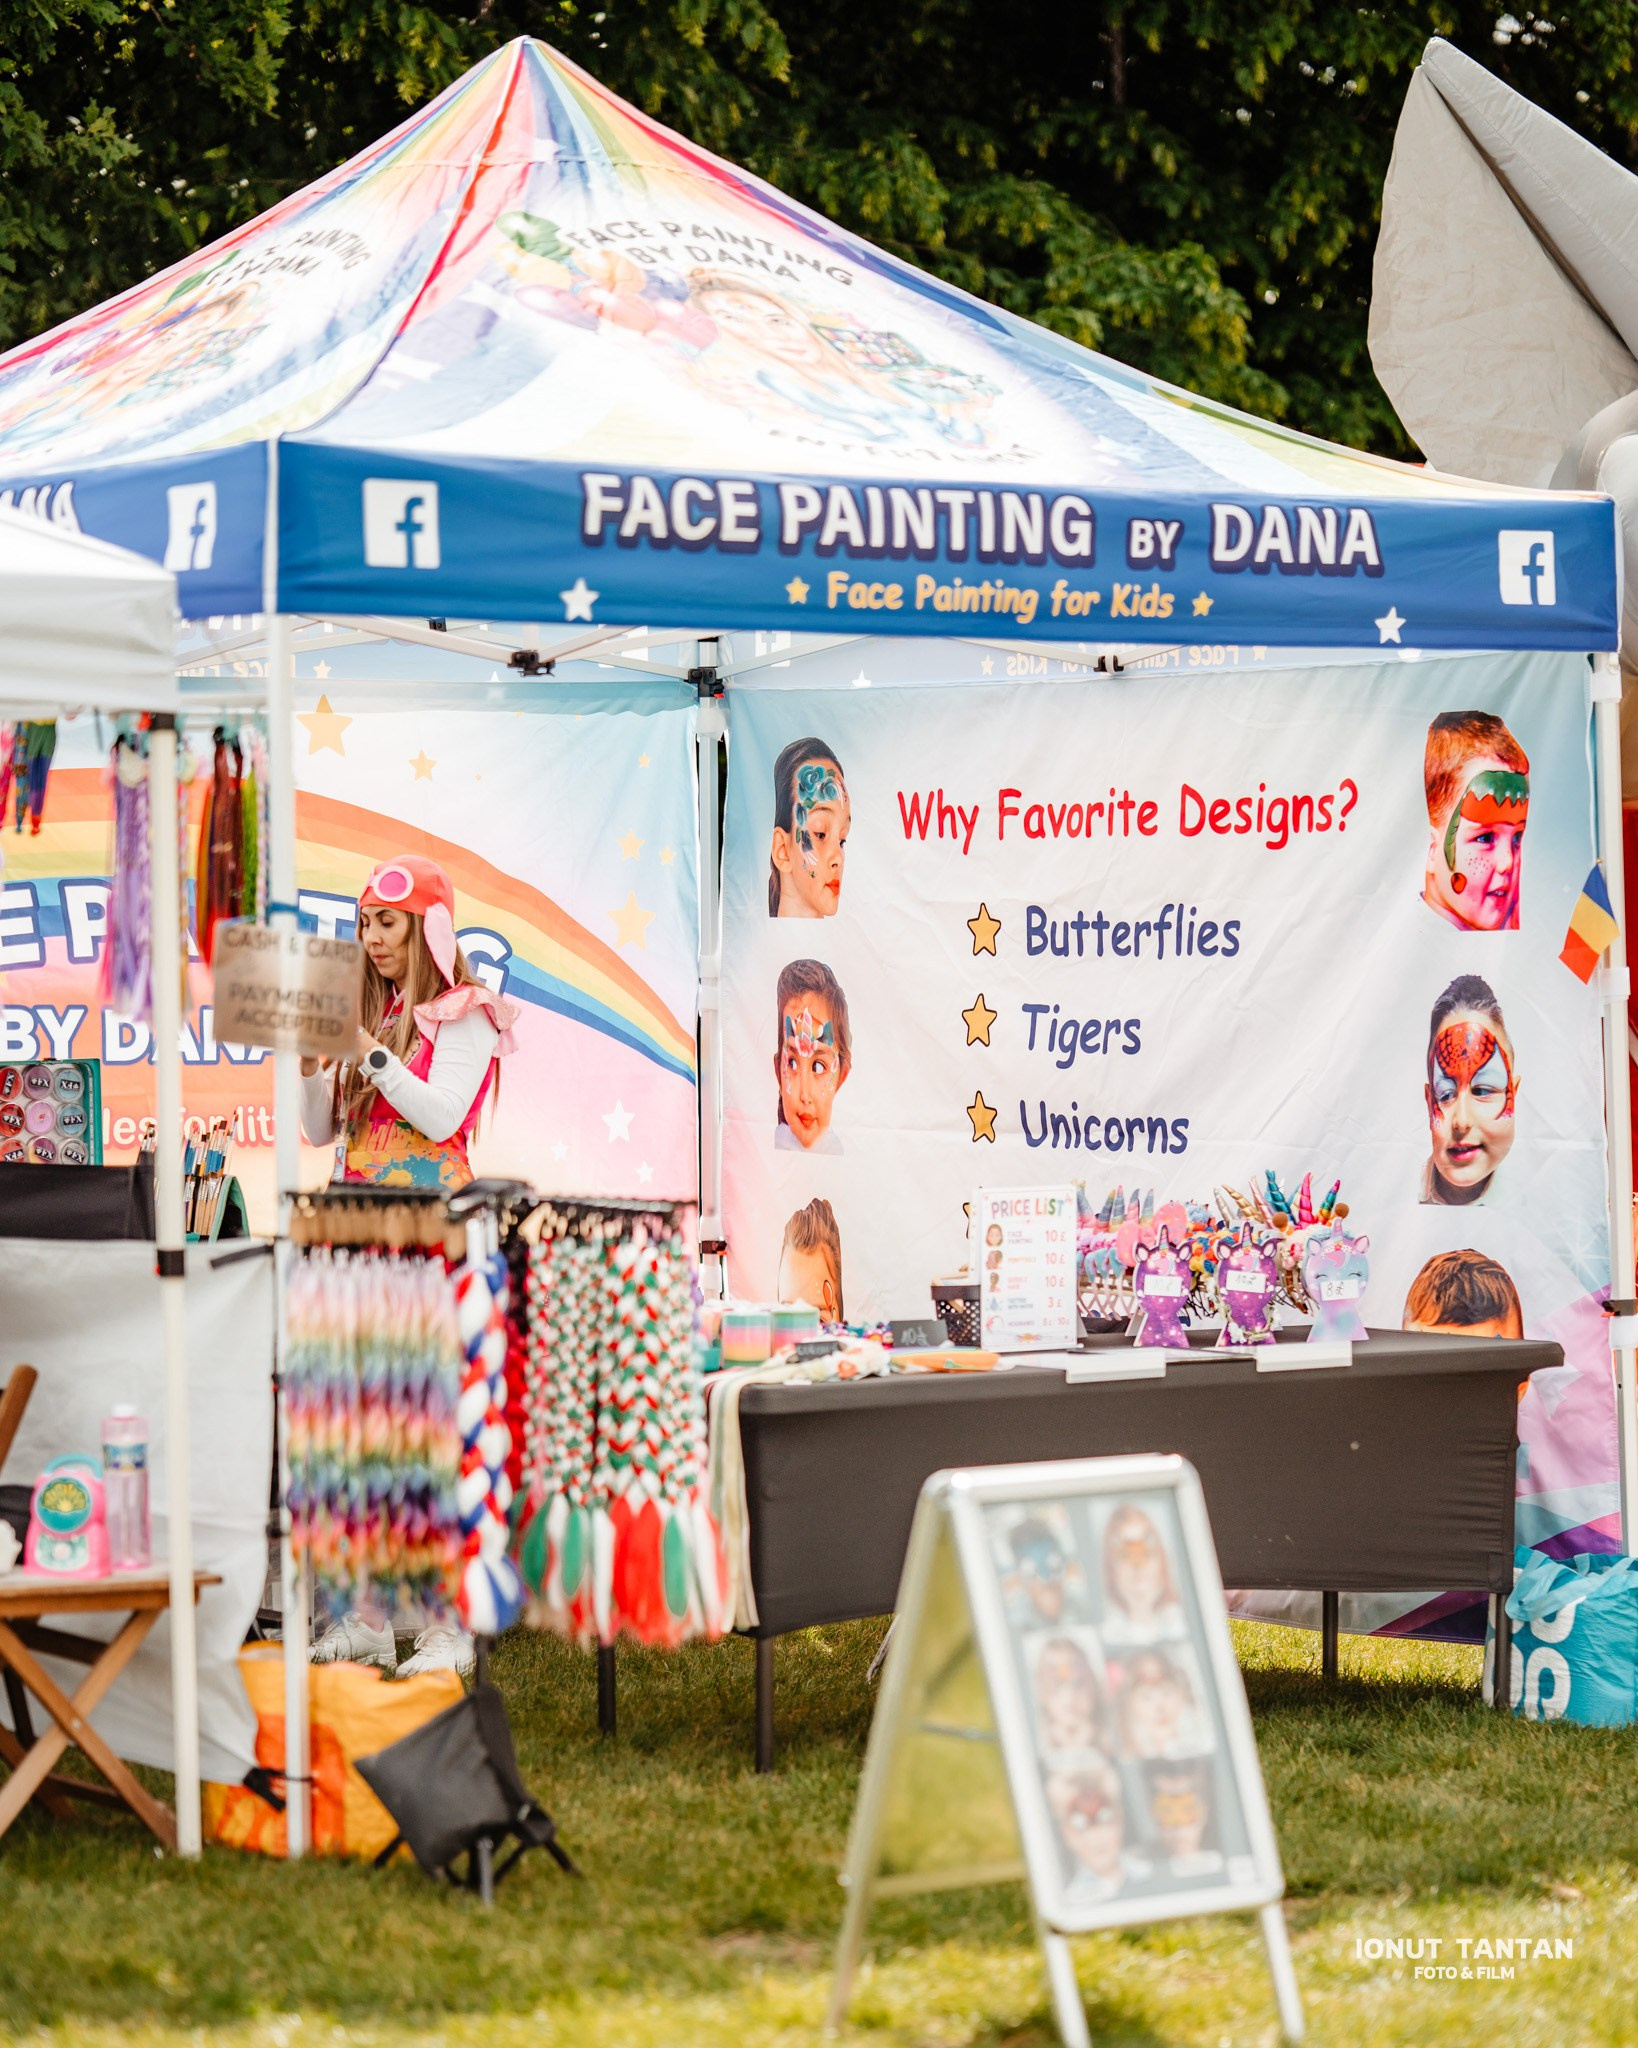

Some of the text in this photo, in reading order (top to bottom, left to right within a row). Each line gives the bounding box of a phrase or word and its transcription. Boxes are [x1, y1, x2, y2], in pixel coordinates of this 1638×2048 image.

[566, 220, 854, 286] FACE PAINTING
[627, 244, 800, 282] BY DANA
[581, 472, 1385, 578] FACE PAINTING BY DANA
[826, 571, 1176, 624] Face Painting for Kids
[897, 777, 1360, 856] Why Favorite Designs?
[222, 926, 280, 951] CASH
[306, 939, 361, 964] CARD
[1025, 903, 1242, 960] Butterflies
[228, 982, 350, 1017] PAYMENTS
[235, 1009, 345, 1037] ACCEPTED
[1021, 1003, 1142, 1070] Tigers
[1019, 1100, 1190, 1155] Unicorns
[991, 1199, 1031, 1219] PRICE
[1045, 1230, 1057, 1242] 10
[1060, 1231, 1066, 1242] £
[1045, 1252, 1057, 1265] 10
[1059, 1254, 1065, 1264] £
[1045, 1275, 1065, 1288] 10 £
[1048, 1296, 1063, 1308] 3 £
